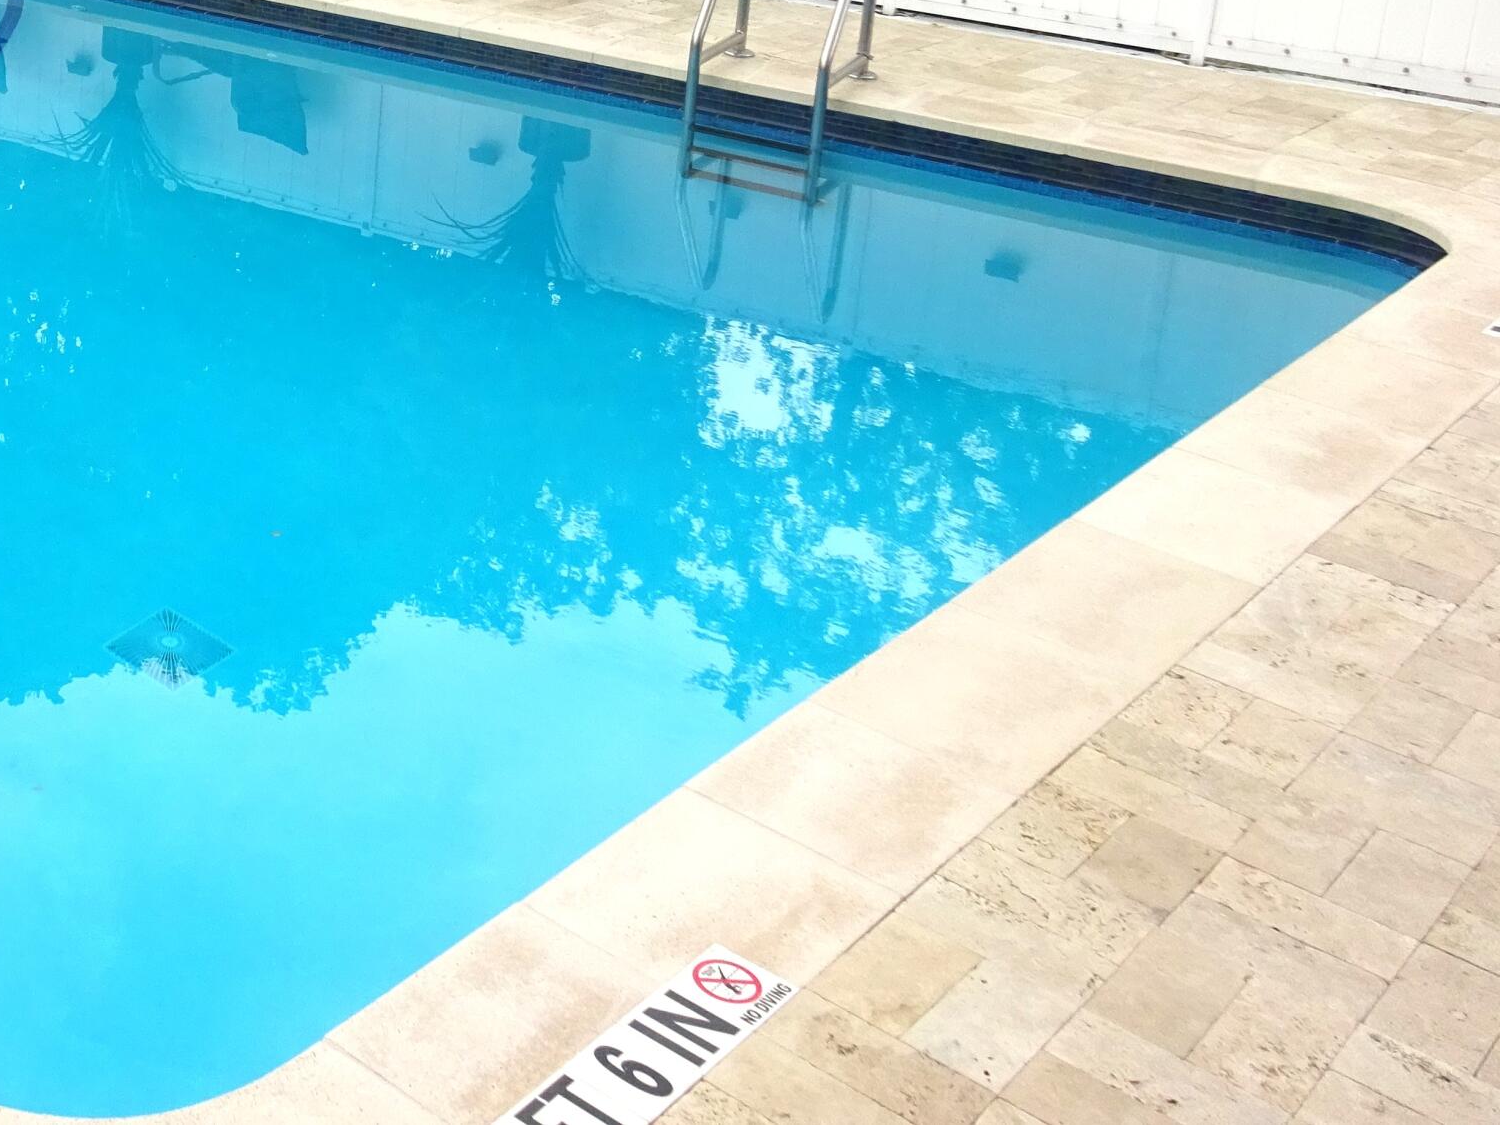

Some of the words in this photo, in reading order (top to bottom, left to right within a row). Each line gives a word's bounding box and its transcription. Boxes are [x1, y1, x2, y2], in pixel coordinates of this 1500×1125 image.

[628, 989, 740, 1067] IN
[740, 1009, 762, 1025] NO
[754, 983, 792, 1013] DIVING
[594, 1045, 673, 1097] 6
